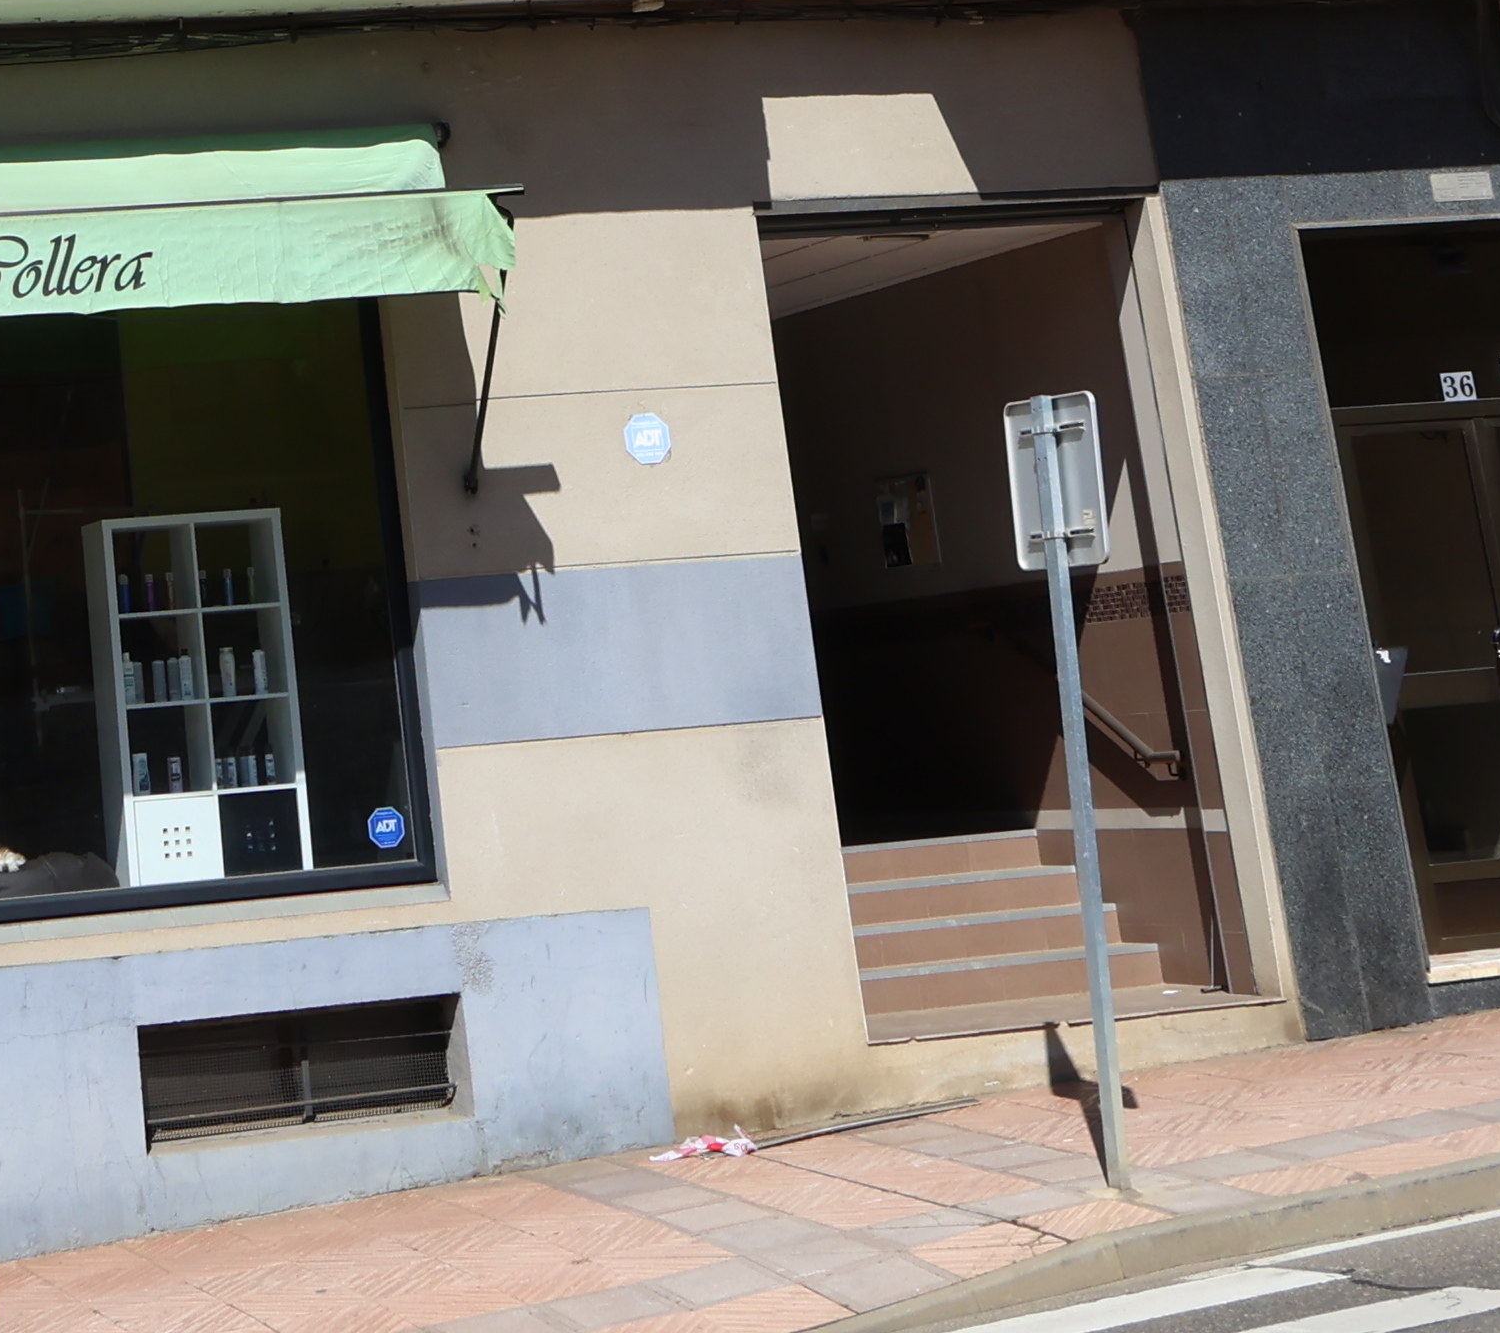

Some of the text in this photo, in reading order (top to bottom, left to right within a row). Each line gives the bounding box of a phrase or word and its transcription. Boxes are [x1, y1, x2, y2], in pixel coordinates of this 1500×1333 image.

[1442, 374, 1474, 399] 36
[633, 428, 662, 448] ADT
[375, 819, 397, 834] ADT
